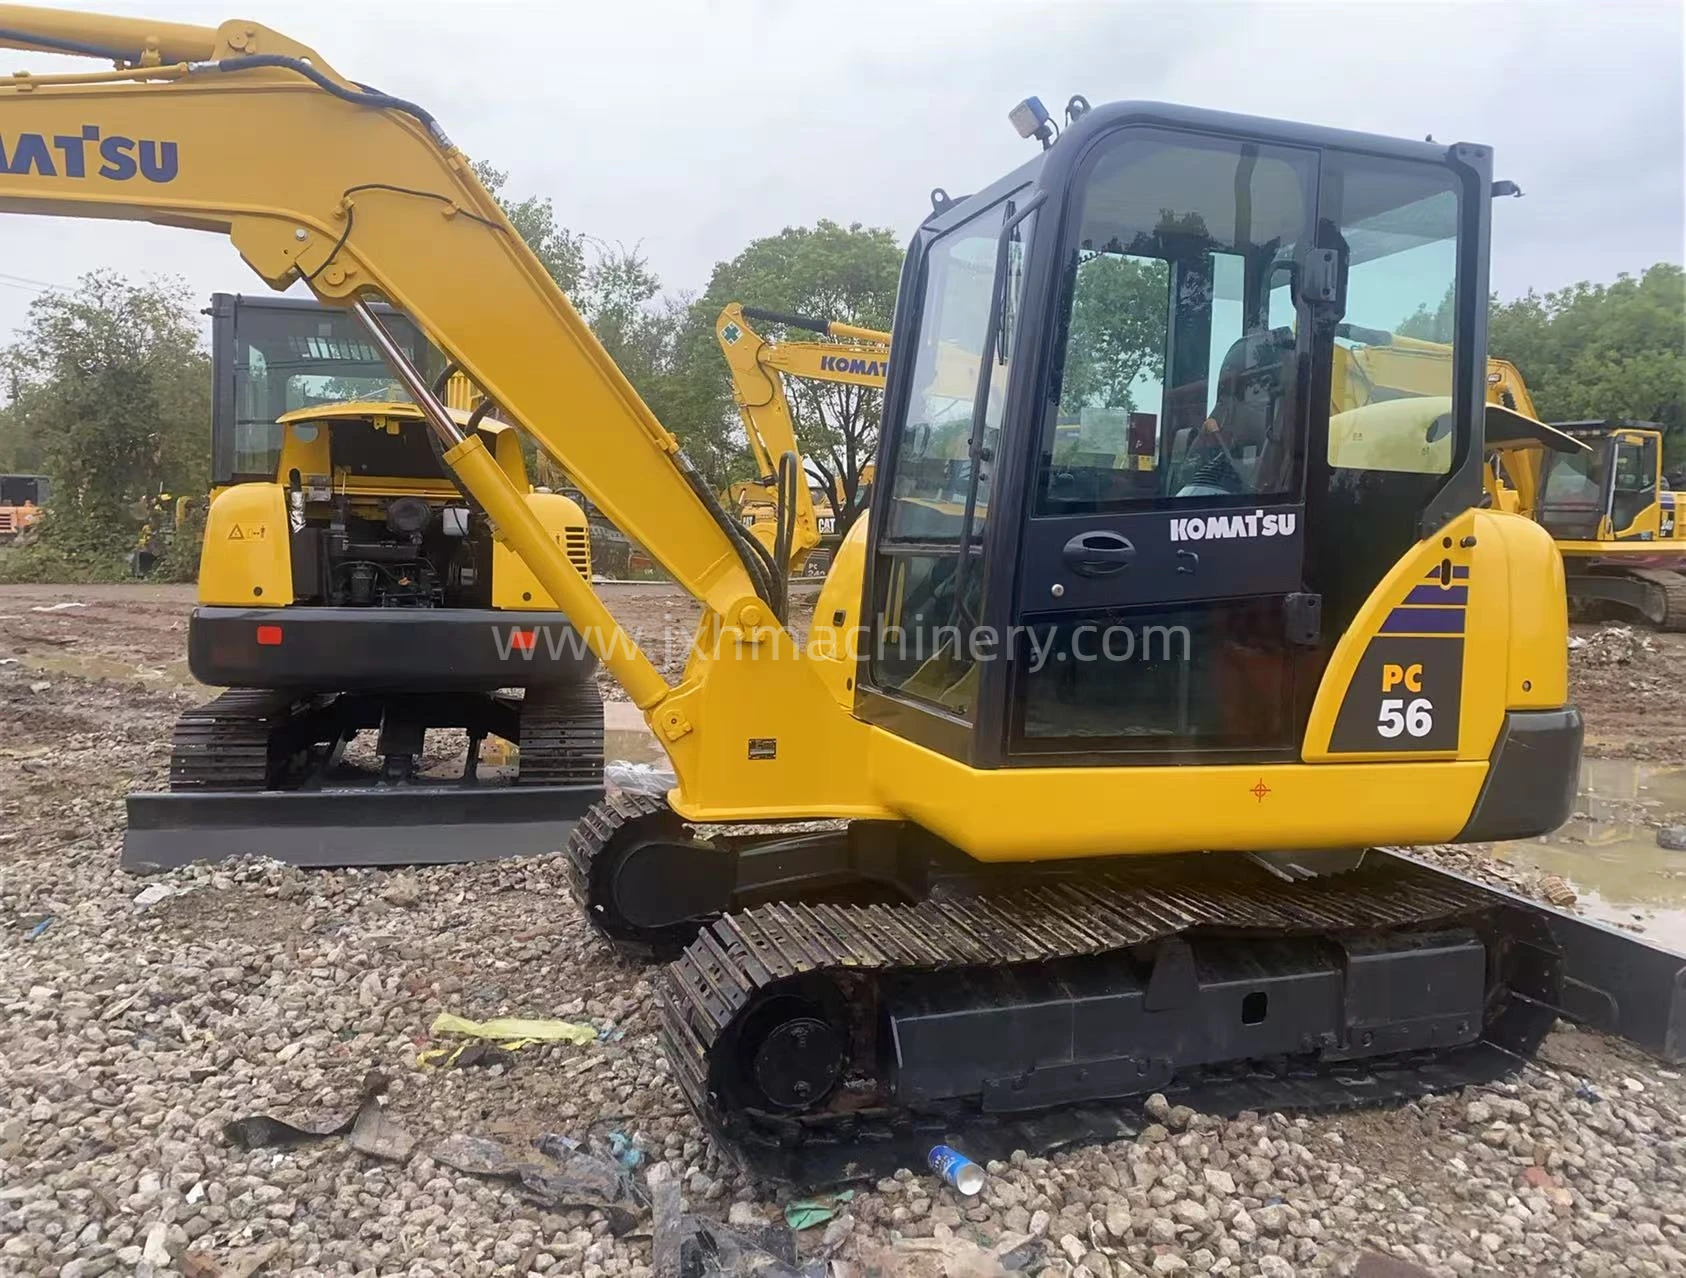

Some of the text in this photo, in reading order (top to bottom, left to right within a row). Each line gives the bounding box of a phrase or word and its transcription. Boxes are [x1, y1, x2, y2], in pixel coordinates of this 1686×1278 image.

[0, 124, 178, 183] ATSU
[818, 518, 836, 534] CAT
[1170, 509, 1296, 541] KOMATSU
[1382, 664, 1422, 692] PC
[1377, 698, 1433, 737] 56
